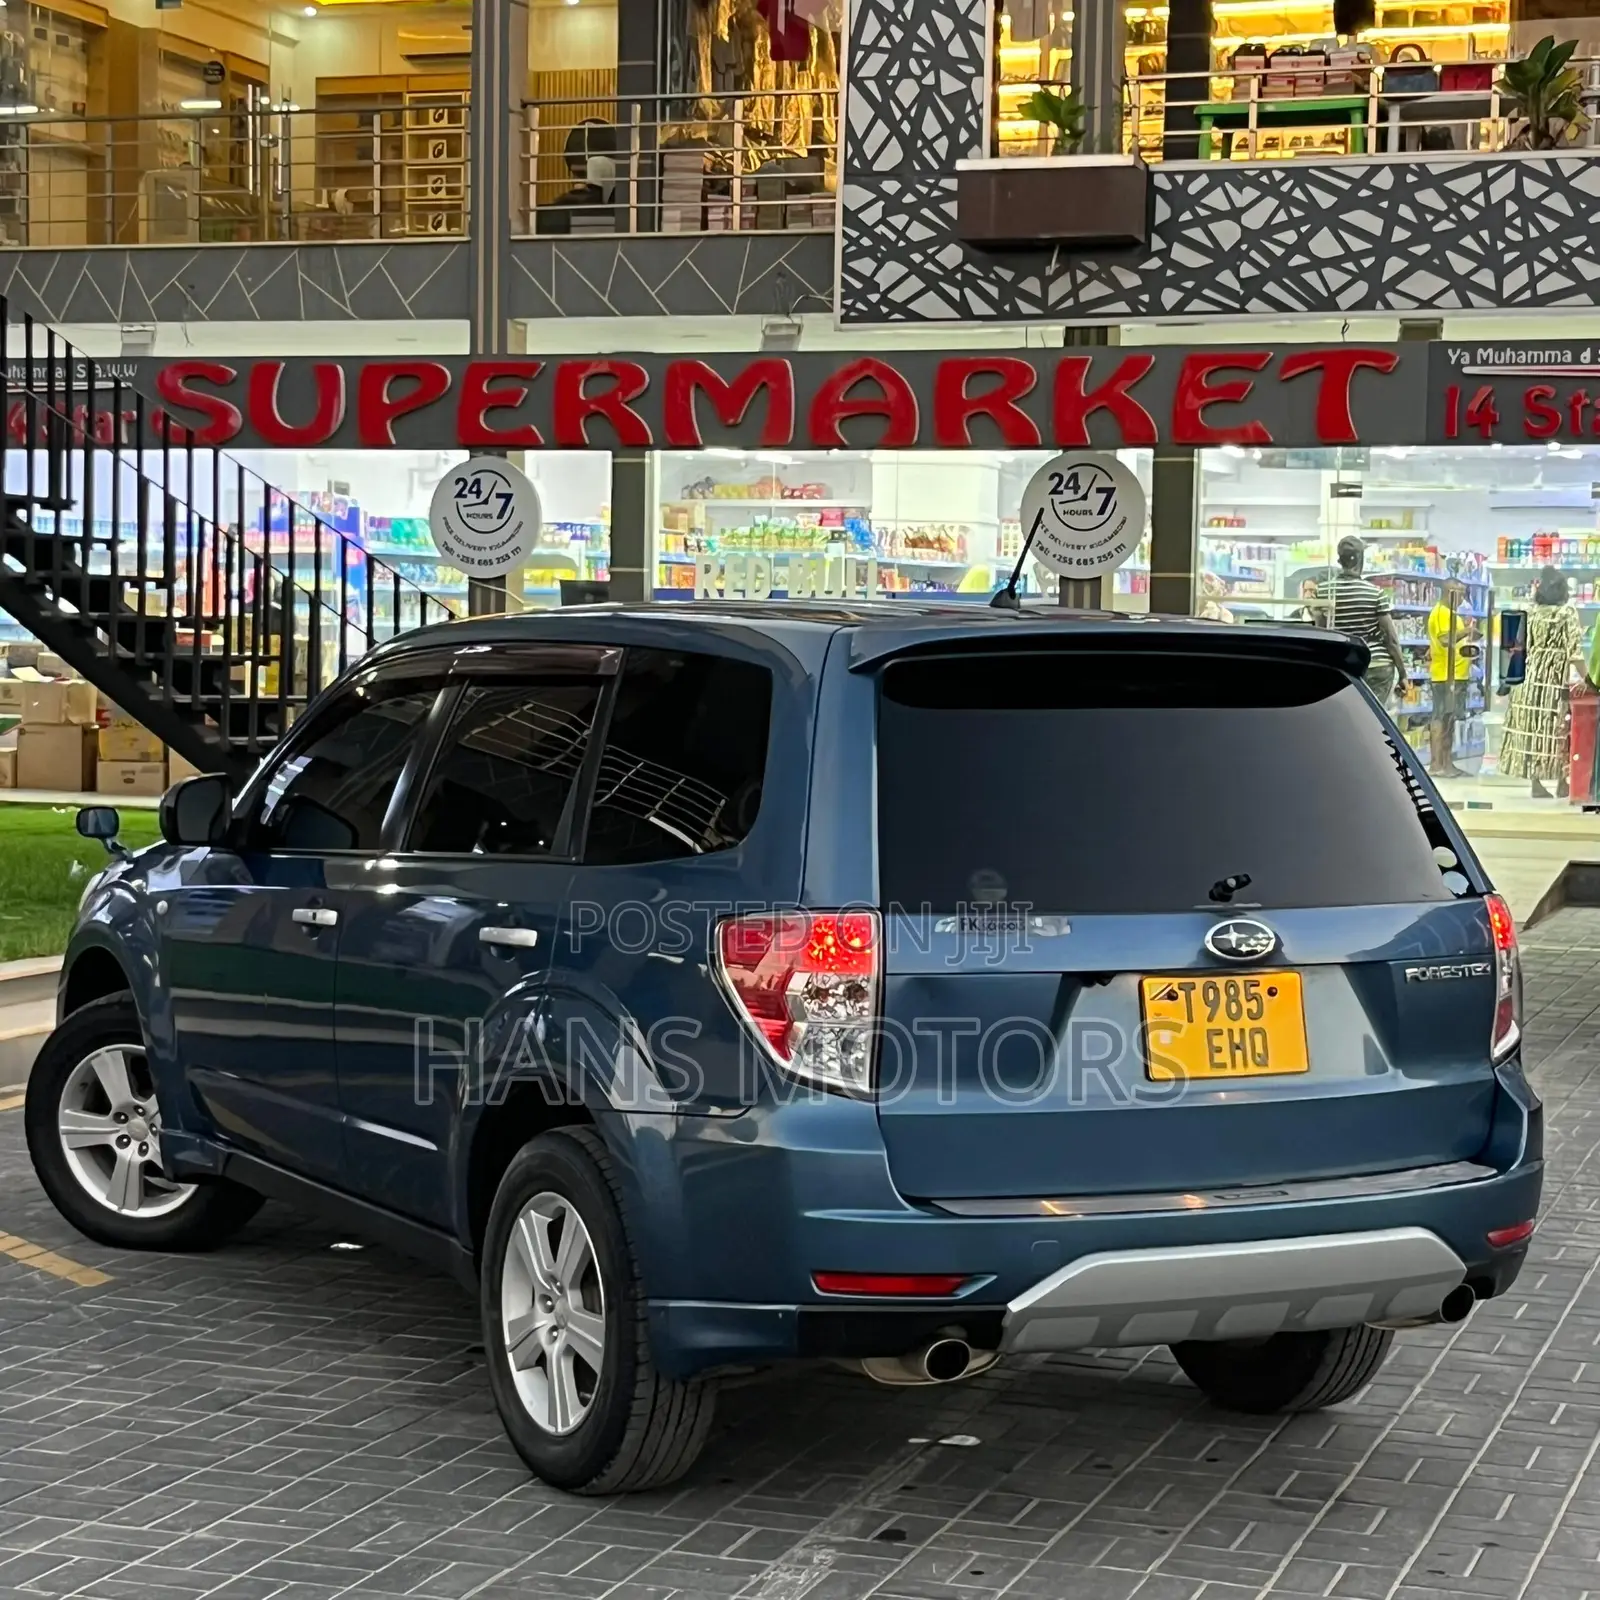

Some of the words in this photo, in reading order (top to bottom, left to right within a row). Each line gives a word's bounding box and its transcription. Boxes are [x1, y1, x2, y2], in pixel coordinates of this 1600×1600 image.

[1447, 348, 1470, 365] Ya
[151, 347, 1399, 447] SUPERMARKET
[1444, 384, 1500, 438] 14
[454, 477, 482, 499] 24
[1048, 472, 1081, 495] 24
[466, 512, 493, 520] HOURS
[1048, 533, 1087, 551] DELIVERY
[694, 556, 773, 600] RED
[1404, 962, 1492, 984] FORESTER
[1178, 979, 1264, 1023] T985
[1206, 1027, 1269, 1069] EHQ
